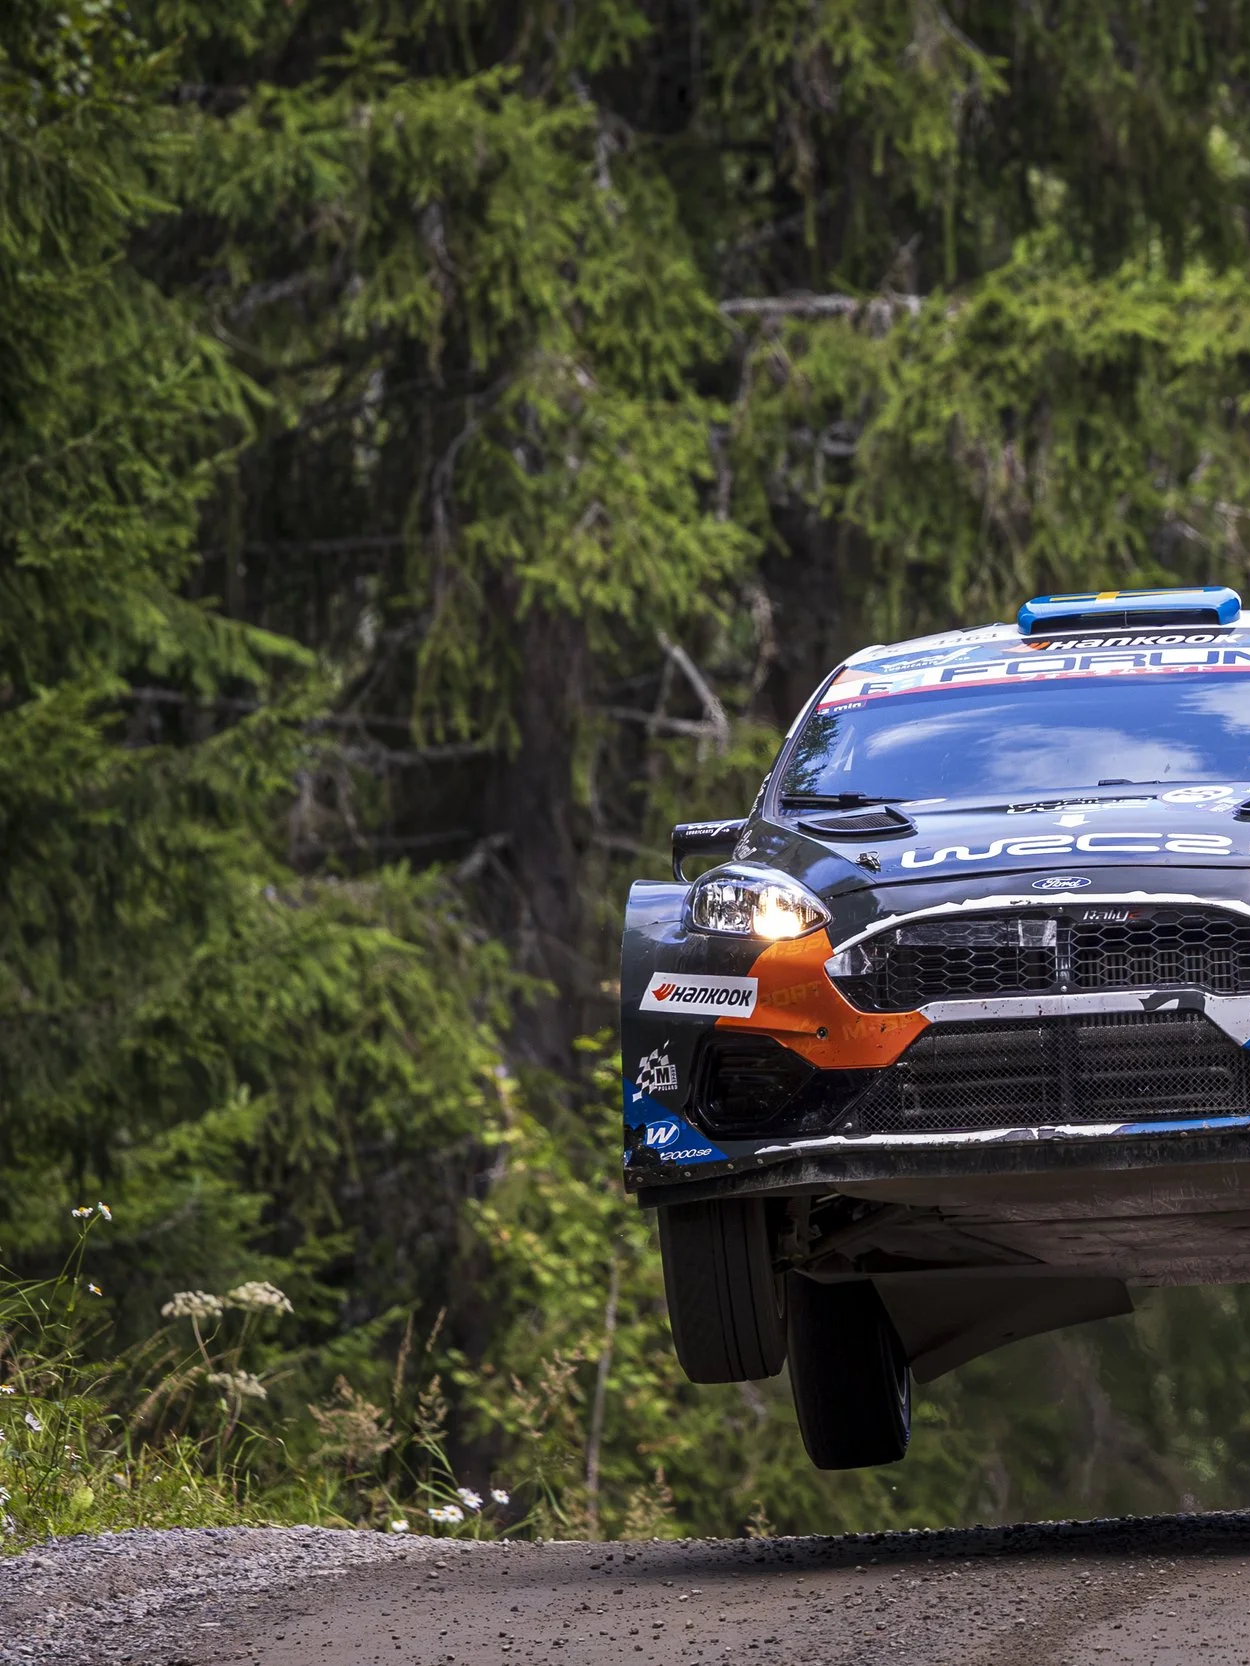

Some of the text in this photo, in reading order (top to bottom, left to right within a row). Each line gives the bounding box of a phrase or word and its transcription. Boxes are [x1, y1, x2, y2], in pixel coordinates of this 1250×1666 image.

[901, 832, 1233, 868] WRC2
[1041, 876, 1082, 889] Ford
[656, 1067, 670, 1084] M
[646, 1124, 678, 1145] W
